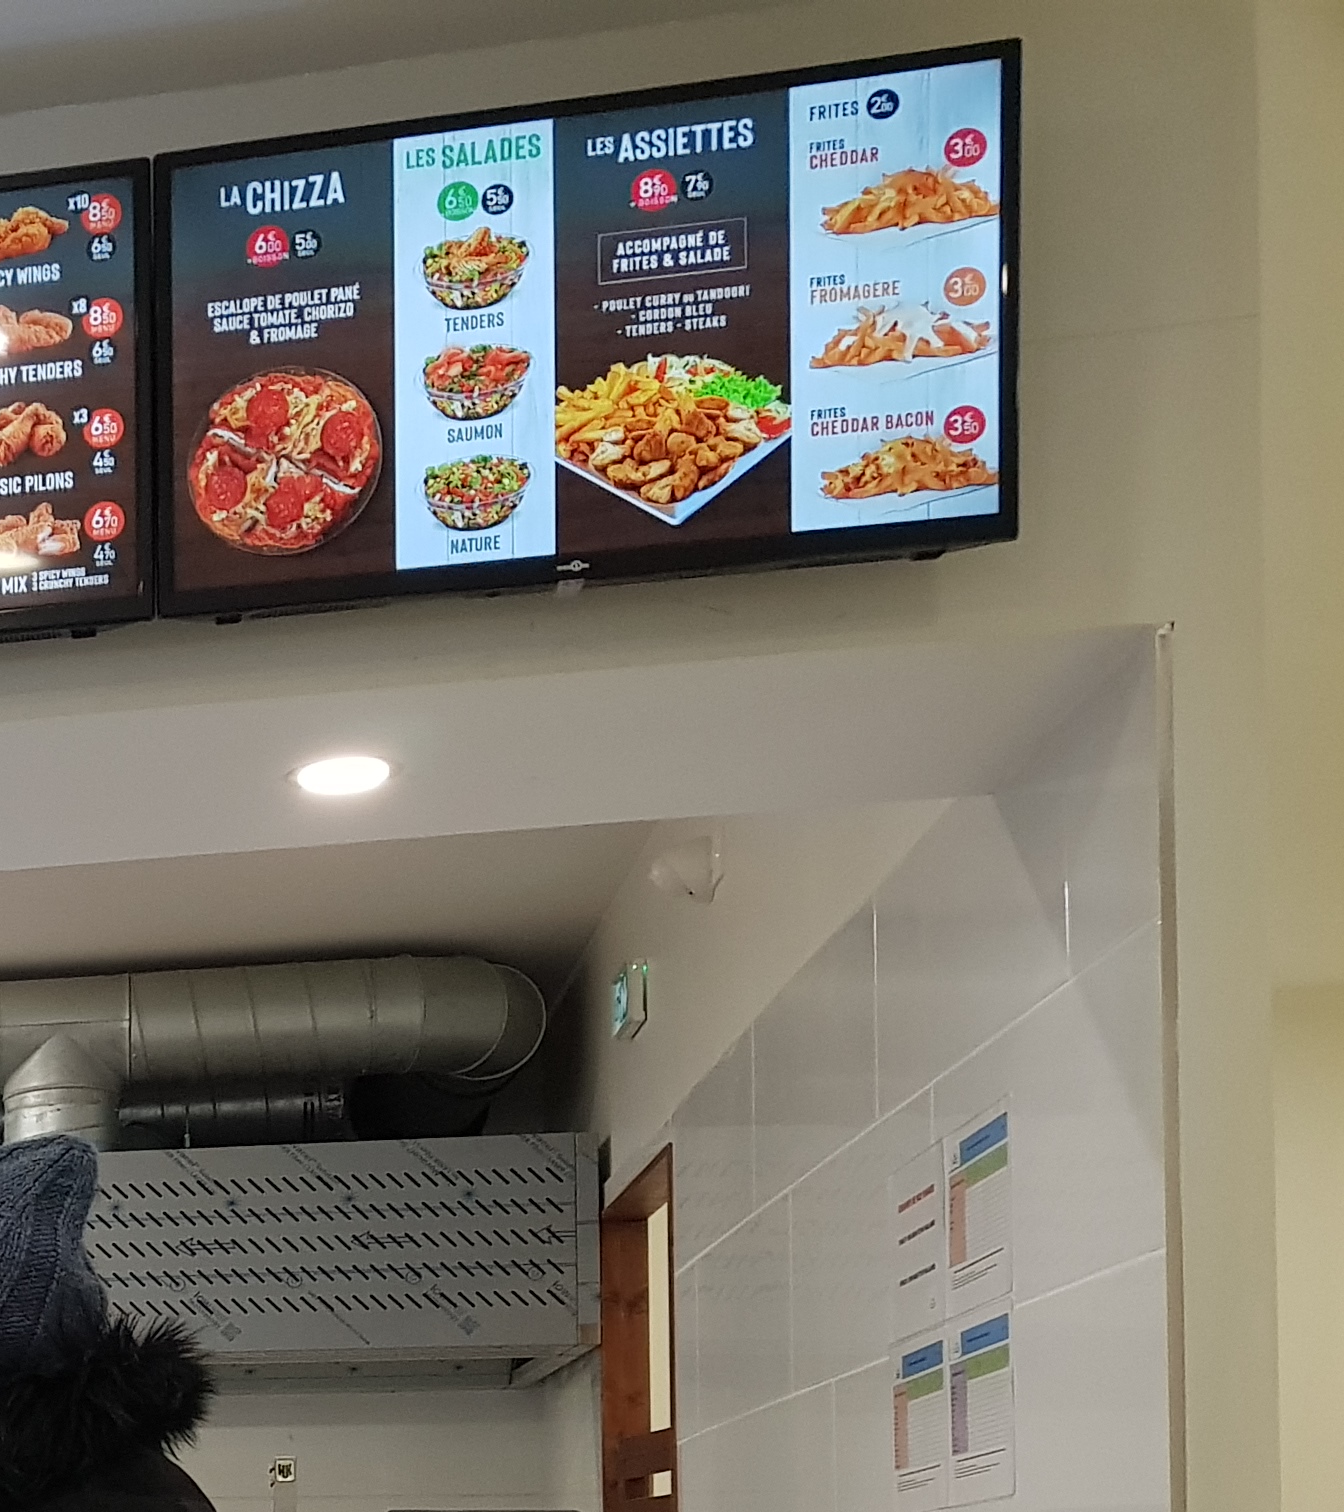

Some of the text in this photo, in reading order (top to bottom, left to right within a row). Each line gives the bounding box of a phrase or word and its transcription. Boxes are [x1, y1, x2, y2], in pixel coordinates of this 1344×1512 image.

[809, 101, 859, 121] FRITES
[406, 133, 541, 169] LES SALADES
[587, 118, 754, 163] LES ASSIETTES
[809, 139, 845, 153] FRITES
[809, 147, 879, 170] CHEDDAR
[219, 171, 345, 215] LA CHIZZA
[616, 230, 726, 256] ACCOMPAGNÉ DE
[612, 245, 731, 273] FRITES & SALADE
[17, 264, 60, 283] WINGS
[809, 275, 846, 288] FRITES
[207, 283, 361, 318] ESCALOPE DE POULET PANÉ
[645, 292, 681, 307] CURRY
[696, 284, 750, 301] TANDOORI
[213, 314, 250, 333] SAUCE
[303, 302, 354, 323] CHORIZO
[444, 313, 505, 333] TENDERS
[639, 303, 713, 322] CORDON BLEU
[249, 322, 318, 345] & FROMAGE
[625, 315, 727, 337] TENDERS STEAKS
[21, 359, 83, 383] TENDERS
[811, 407, 846, 420] FRITES
[811, 411, 934, 437] CHEDDAR BACON
[447, 423, 503, 443] SAUMON
[25, 471, 73, 492] PILONS
[450, 535, 501, 555] NATURE
[2, 575, 27, 594] MIX
